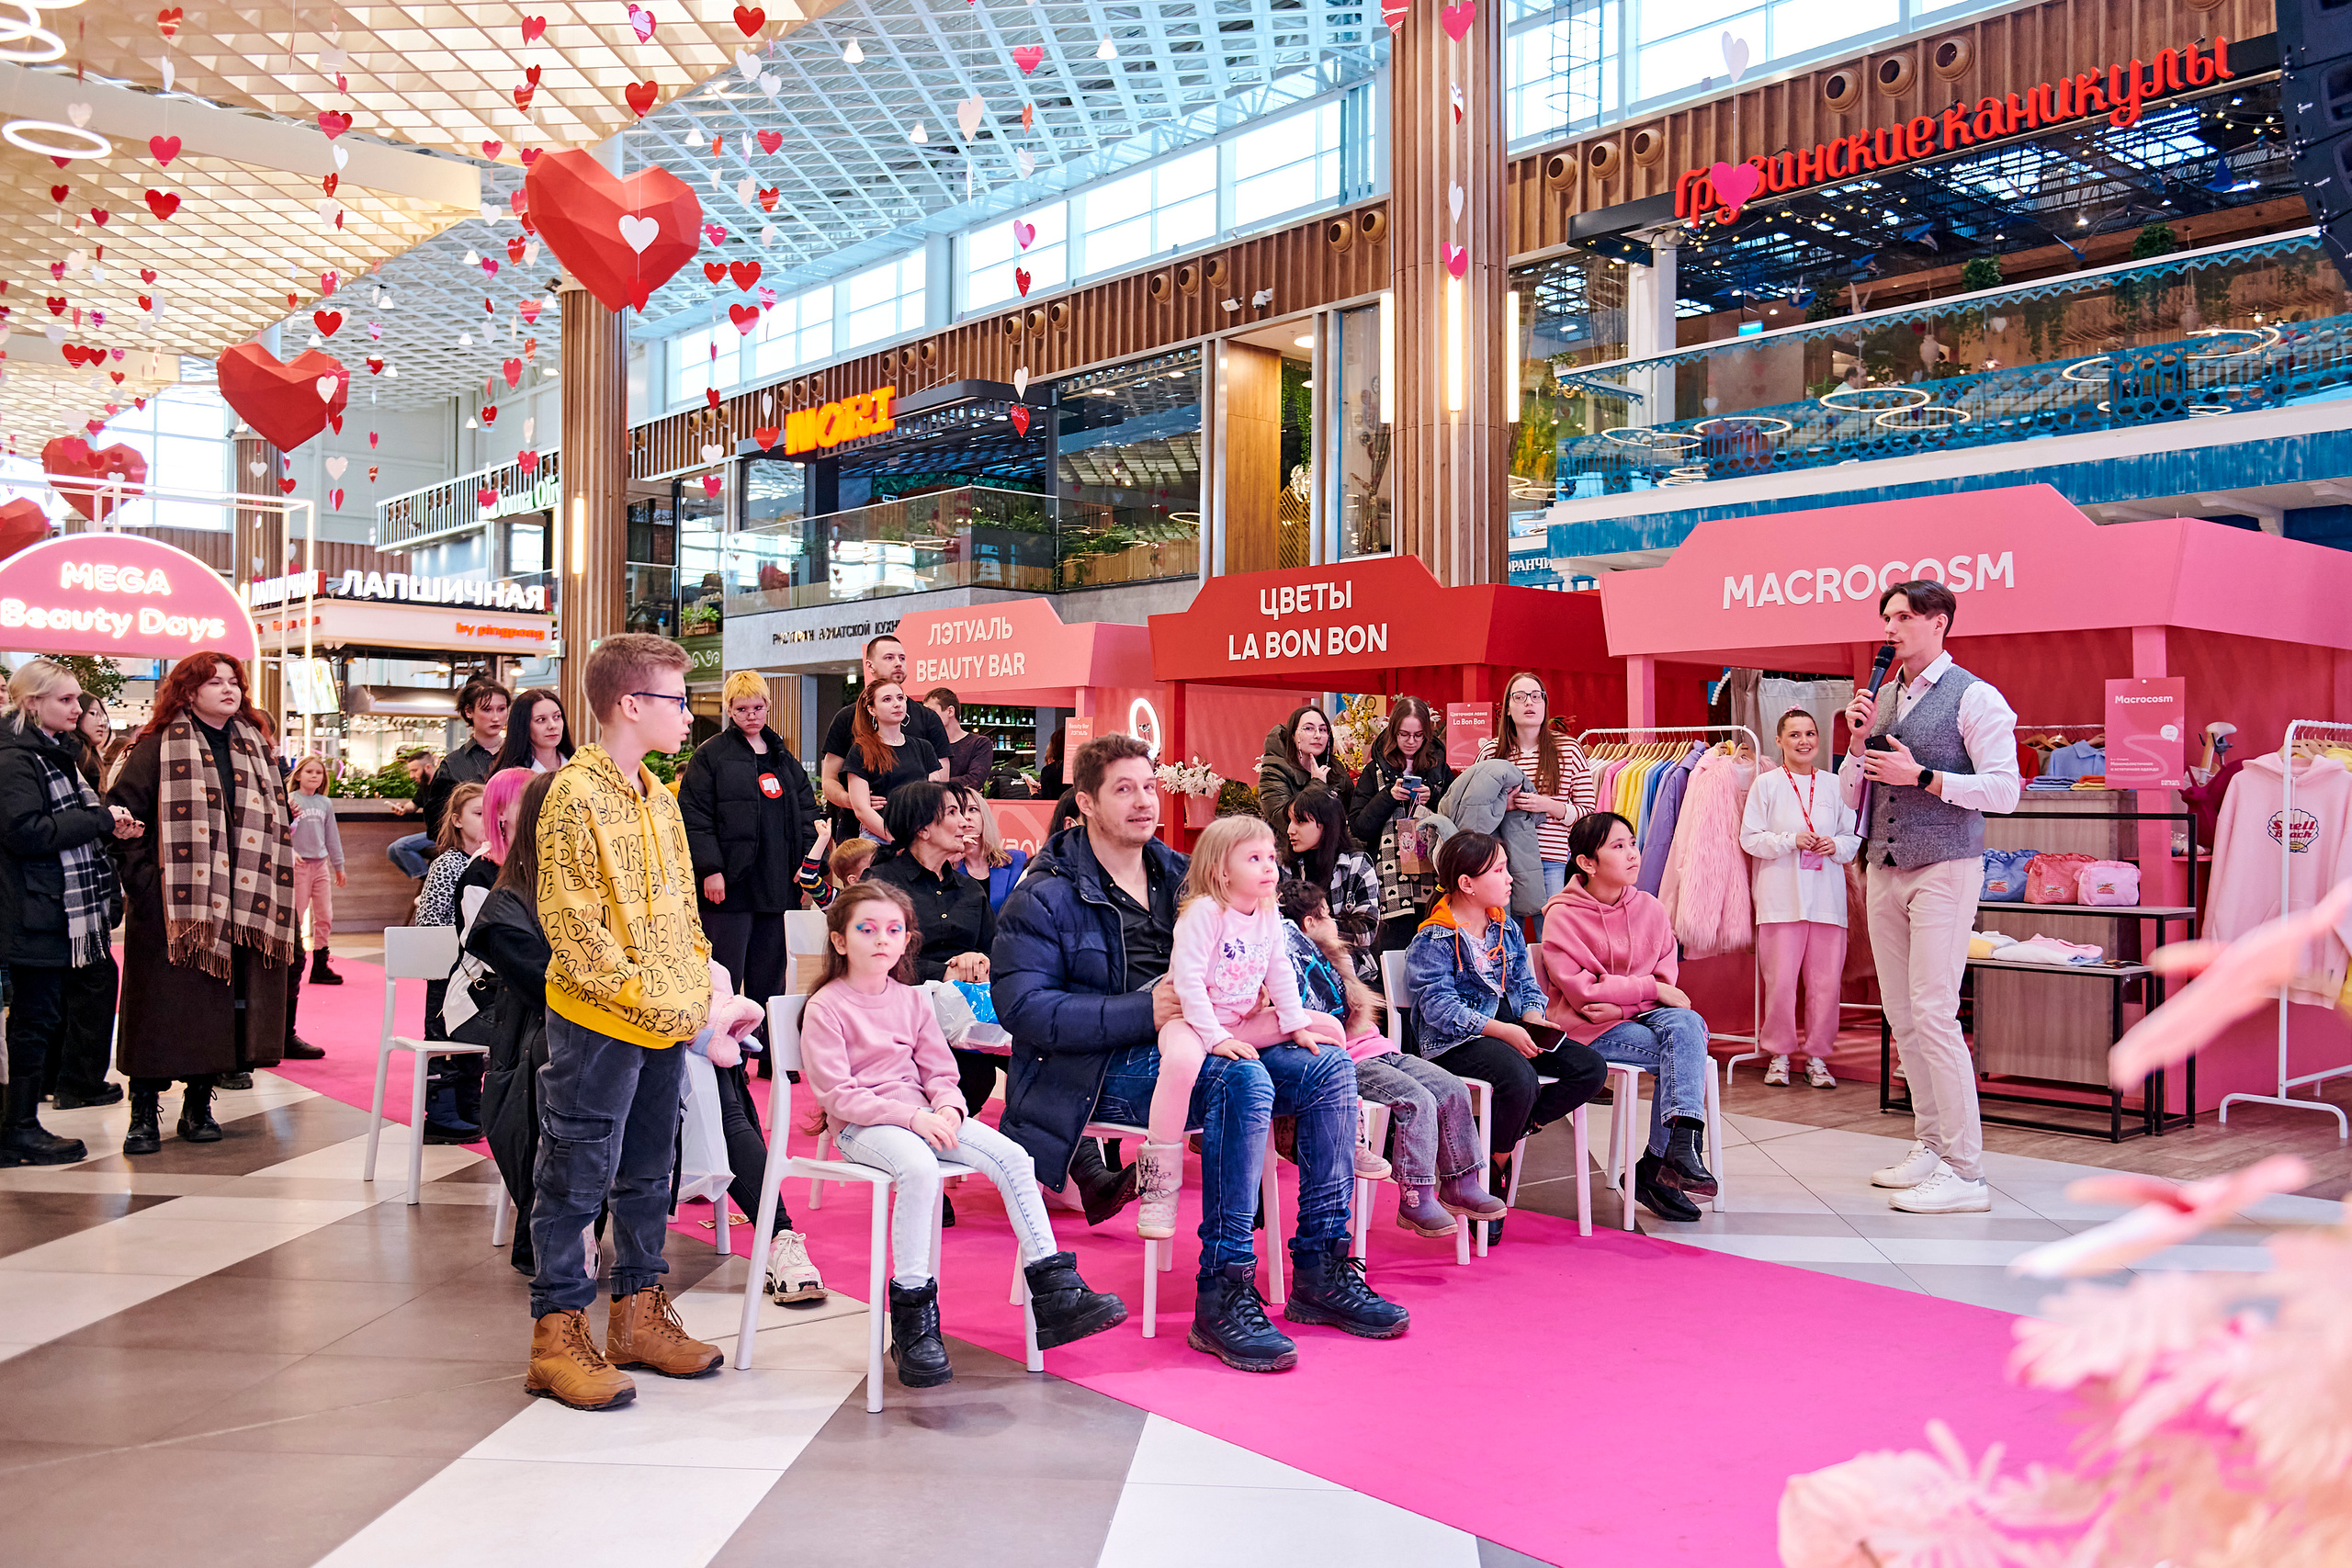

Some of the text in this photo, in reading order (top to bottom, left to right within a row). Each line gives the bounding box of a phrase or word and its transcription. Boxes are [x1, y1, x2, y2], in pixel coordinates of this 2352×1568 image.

[1943, 35, 2235, 151] каникулы
[785, 385, 896, 456] NORI
[60, 561, 173, 595] MEGA
[338, 570, 546, 611] ЛАПШИЧНАЯ
[1260, 580, 1352, 621] ЦВЕТЫ
[0, 598, 133, 638] Beauty
[140, 607, 226, 643] Days
[456, 622, 546, 641] by pingpong
[927, 616, 1013, 647] ЛЭТУАЛЬ
[1228, 623, 1388, 661] LA BON BON
[916, 652, 1025, 682] BEAUTY BAR
[2115, 695, 2174, 704] Macrocosm
[2272, 820, 2316, 830] Sell
[2274, 830, 2312, 839] Bach
